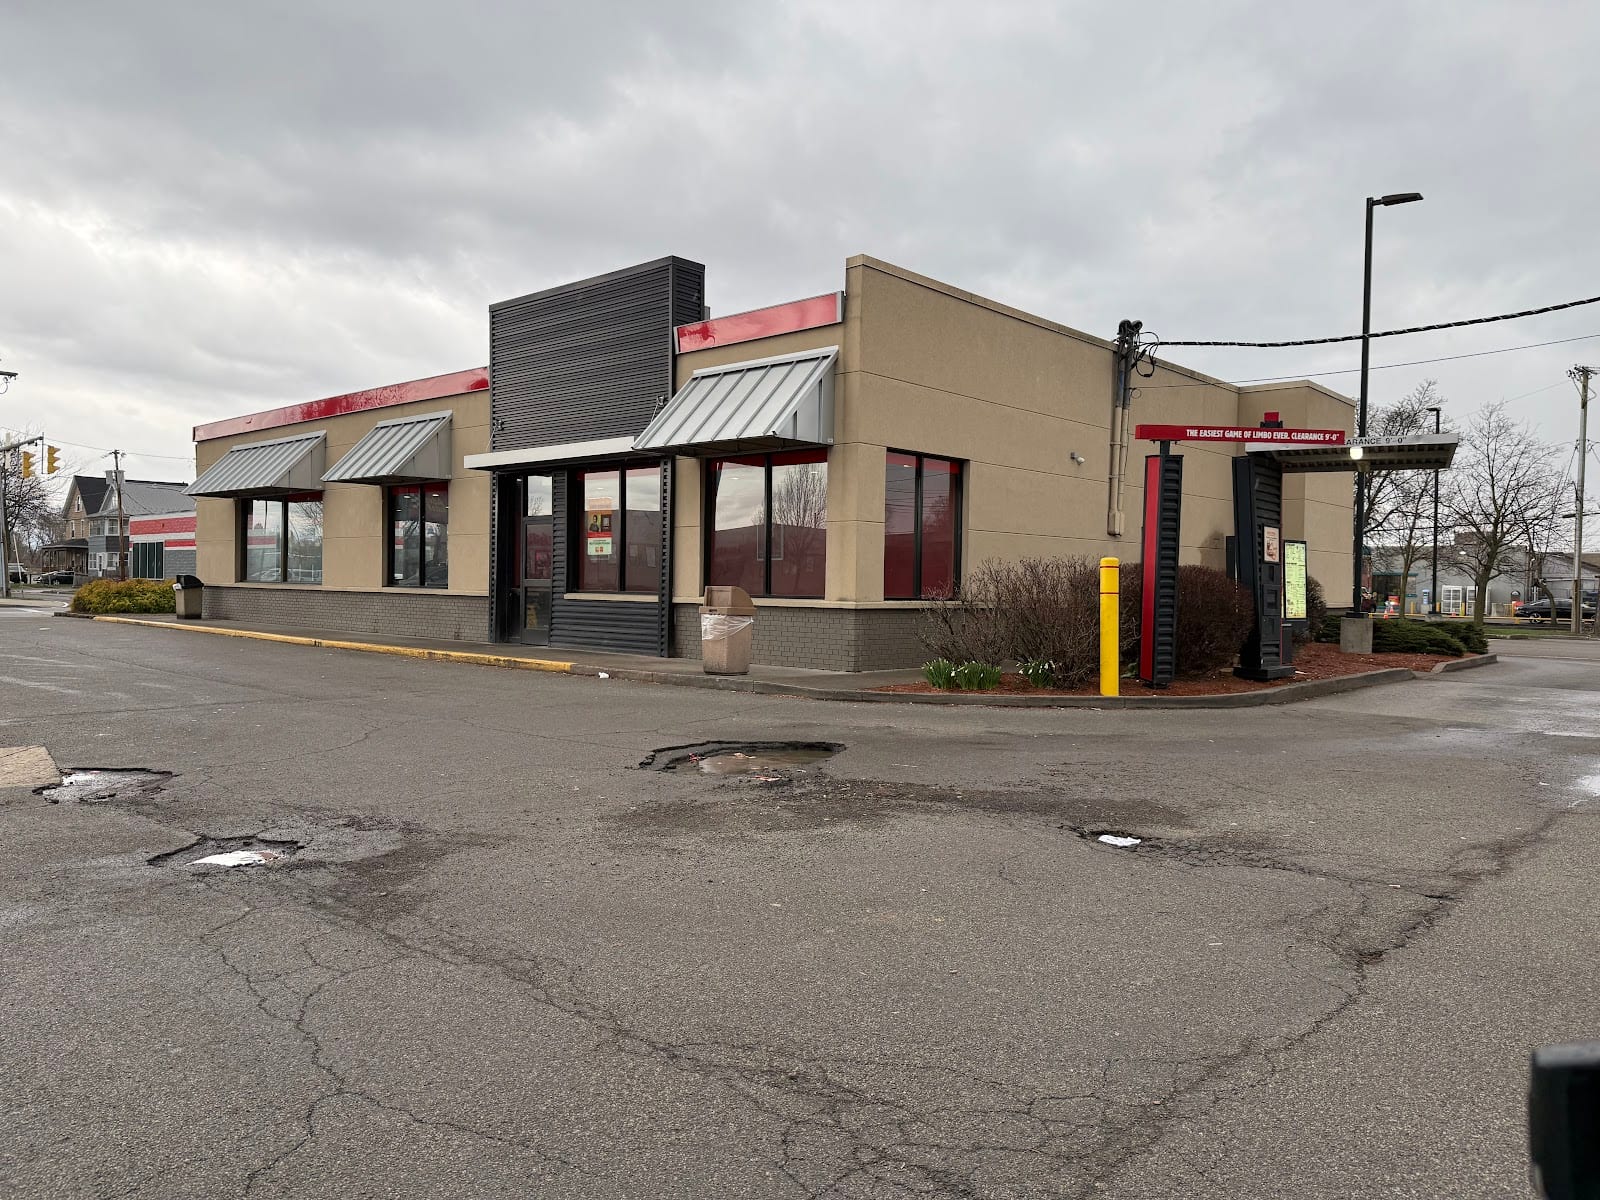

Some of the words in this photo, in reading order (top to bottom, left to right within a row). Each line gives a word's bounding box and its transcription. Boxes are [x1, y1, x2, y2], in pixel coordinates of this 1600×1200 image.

[1186, 429, 1198, 437] THE
[1199, 429, 1223, 438] EASIEST
[1224, 430, 1242, 438] GAME
[1243, 430, 1251, 439] OF
[1252, 430, 1272, 439] LIMBO
[1273, 431, 1290, 440] EVER.
[1291, 432, 1324, 441] CLEARANCE
[1344, 437, 1382, 445] ARANCE
